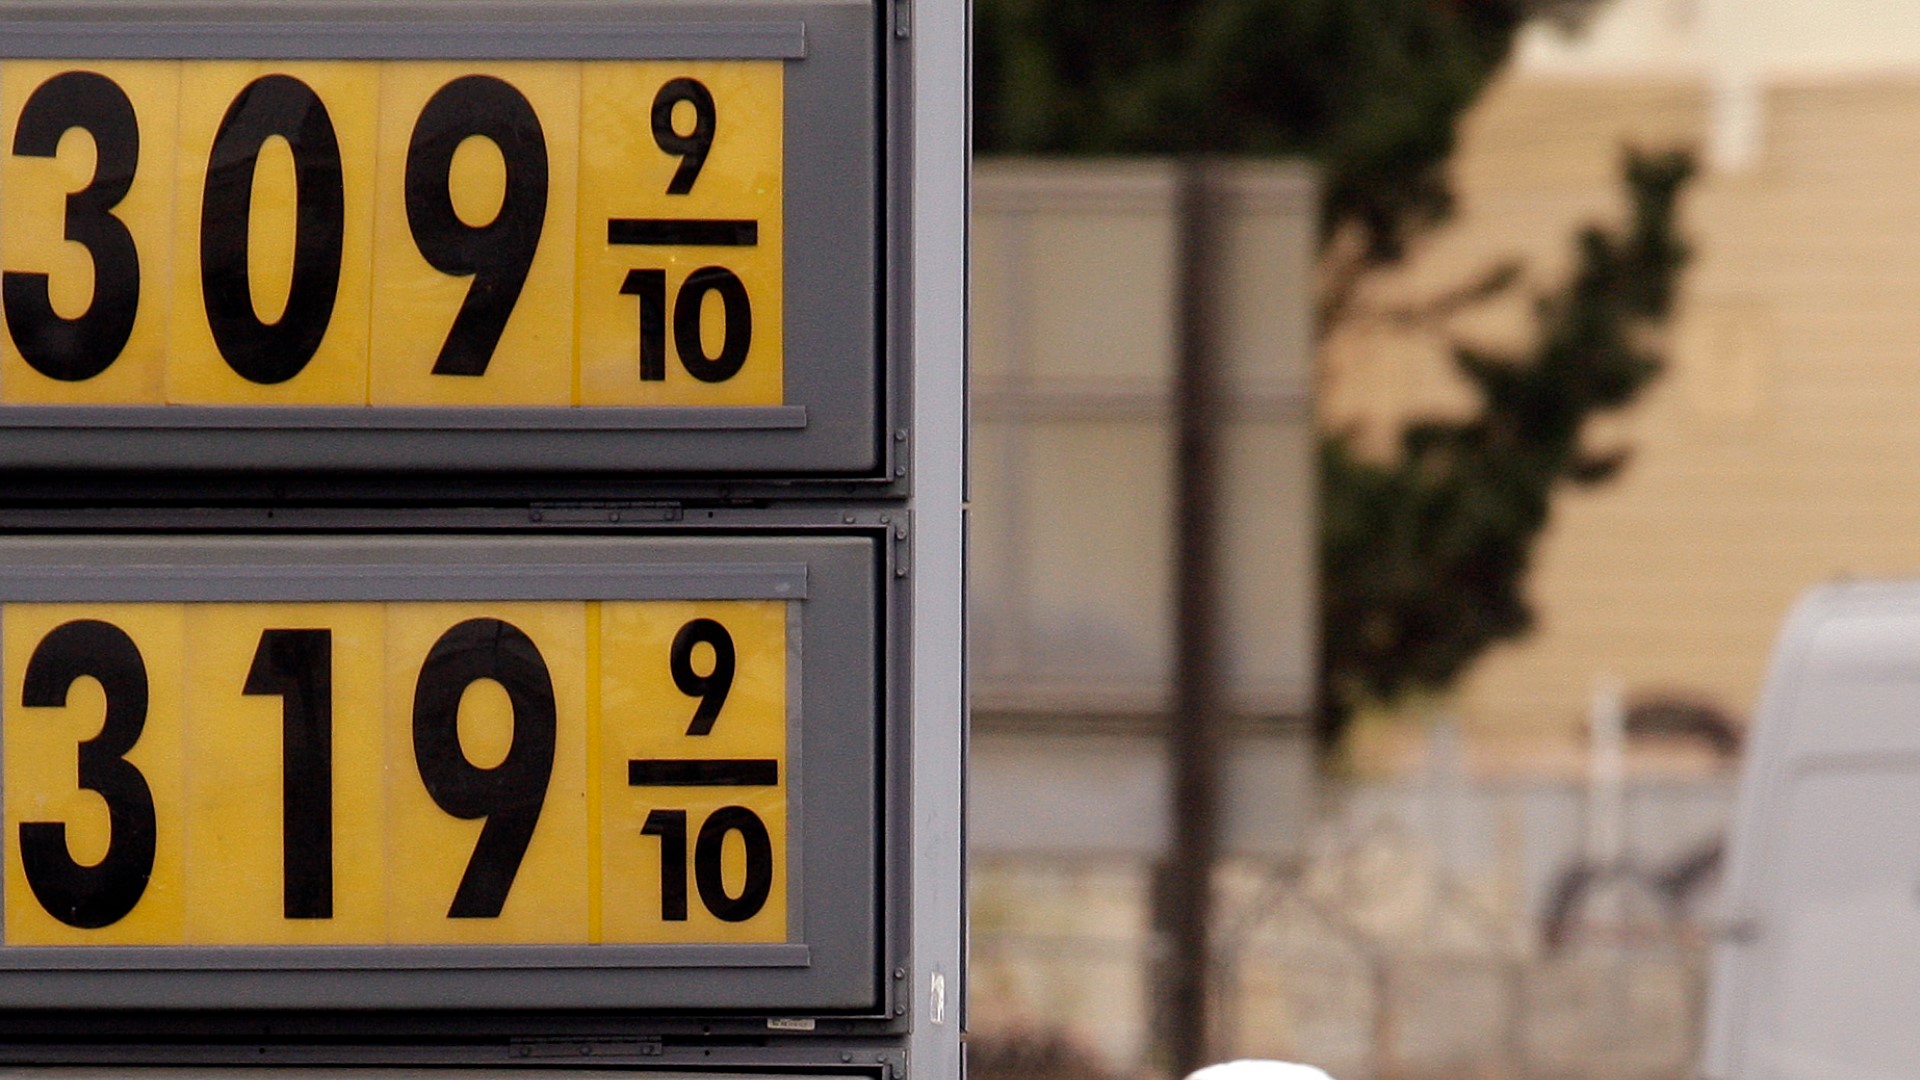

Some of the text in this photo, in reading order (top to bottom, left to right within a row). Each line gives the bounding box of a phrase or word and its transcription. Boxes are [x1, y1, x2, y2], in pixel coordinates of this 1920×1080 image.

[650, 77, 717, 196] 9
[2, 71, 548, 385] 309
[619, 265, 753, 384] 10
[669, 618, 736, 737] 9
[18, 617, 557, 930] 319
[639, 805, 773, 923] 10
